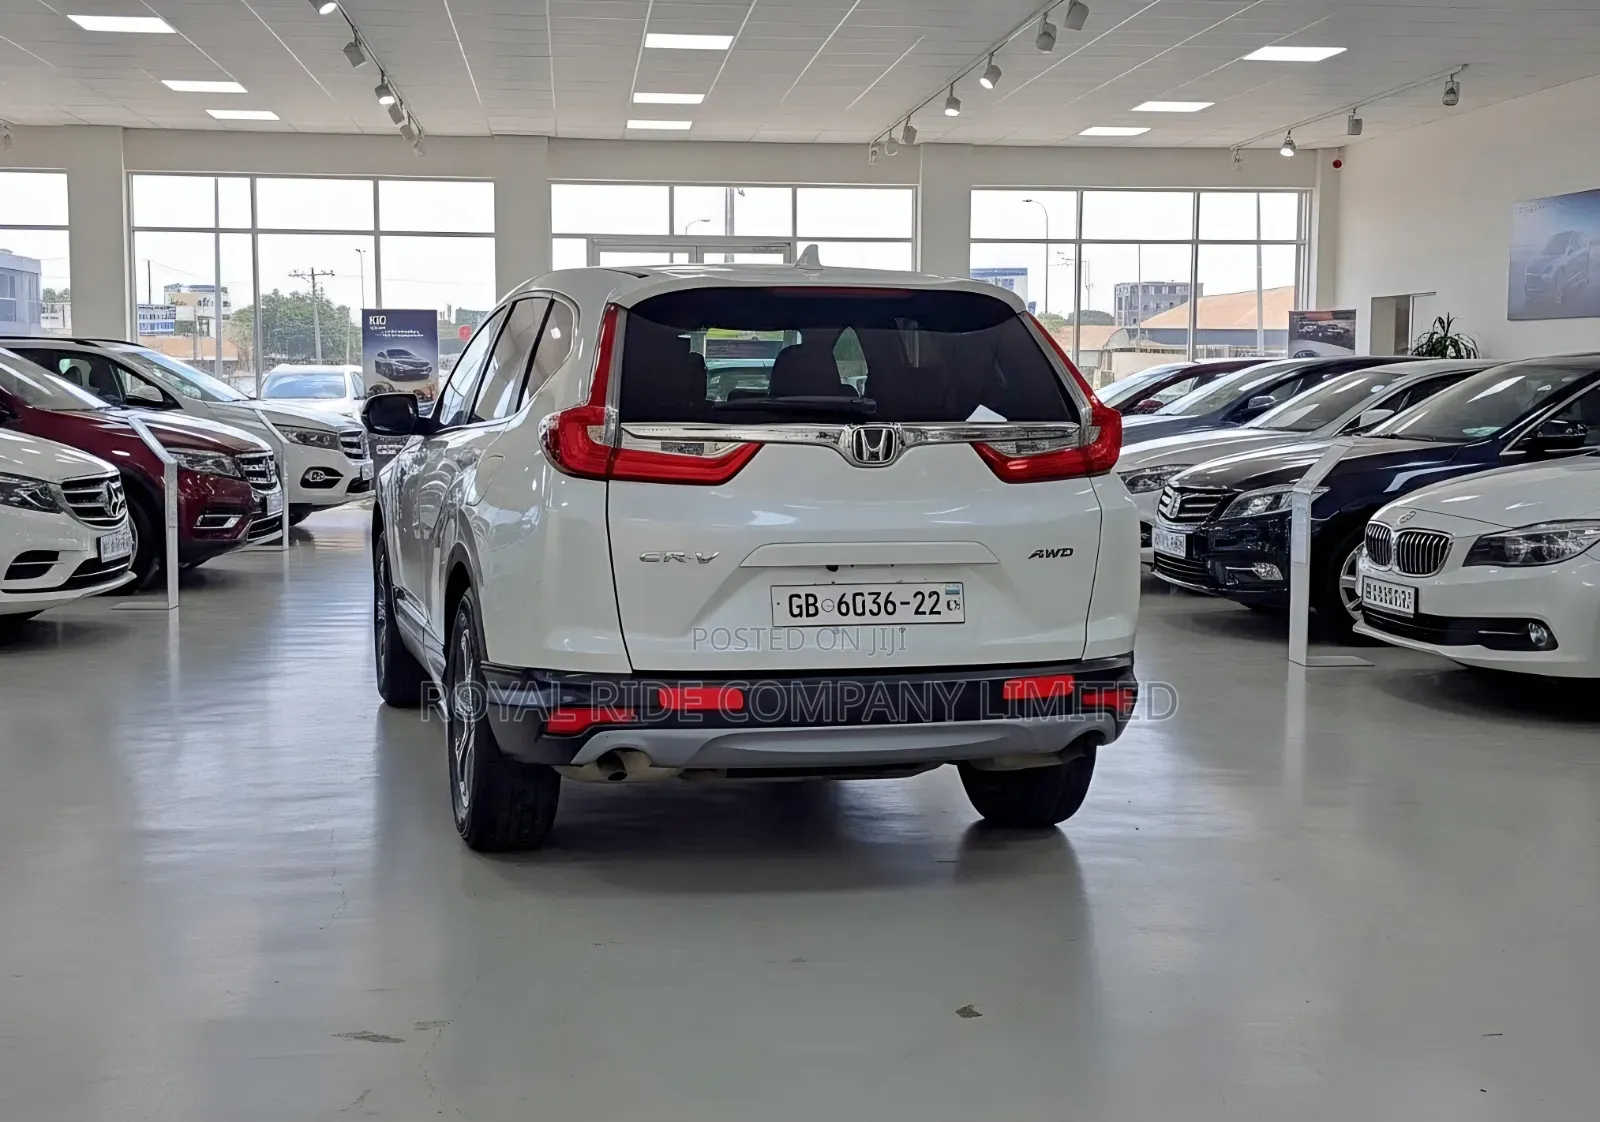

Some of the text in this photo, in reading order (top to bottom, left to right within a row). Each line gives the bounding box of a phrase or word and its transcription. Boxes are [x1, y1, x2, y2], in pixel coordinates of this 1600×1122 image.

[1028, 548, 1074, 560] AWD
[788, 593, 819, 618] GB
[836, 590, 942, 617] 6036-22
